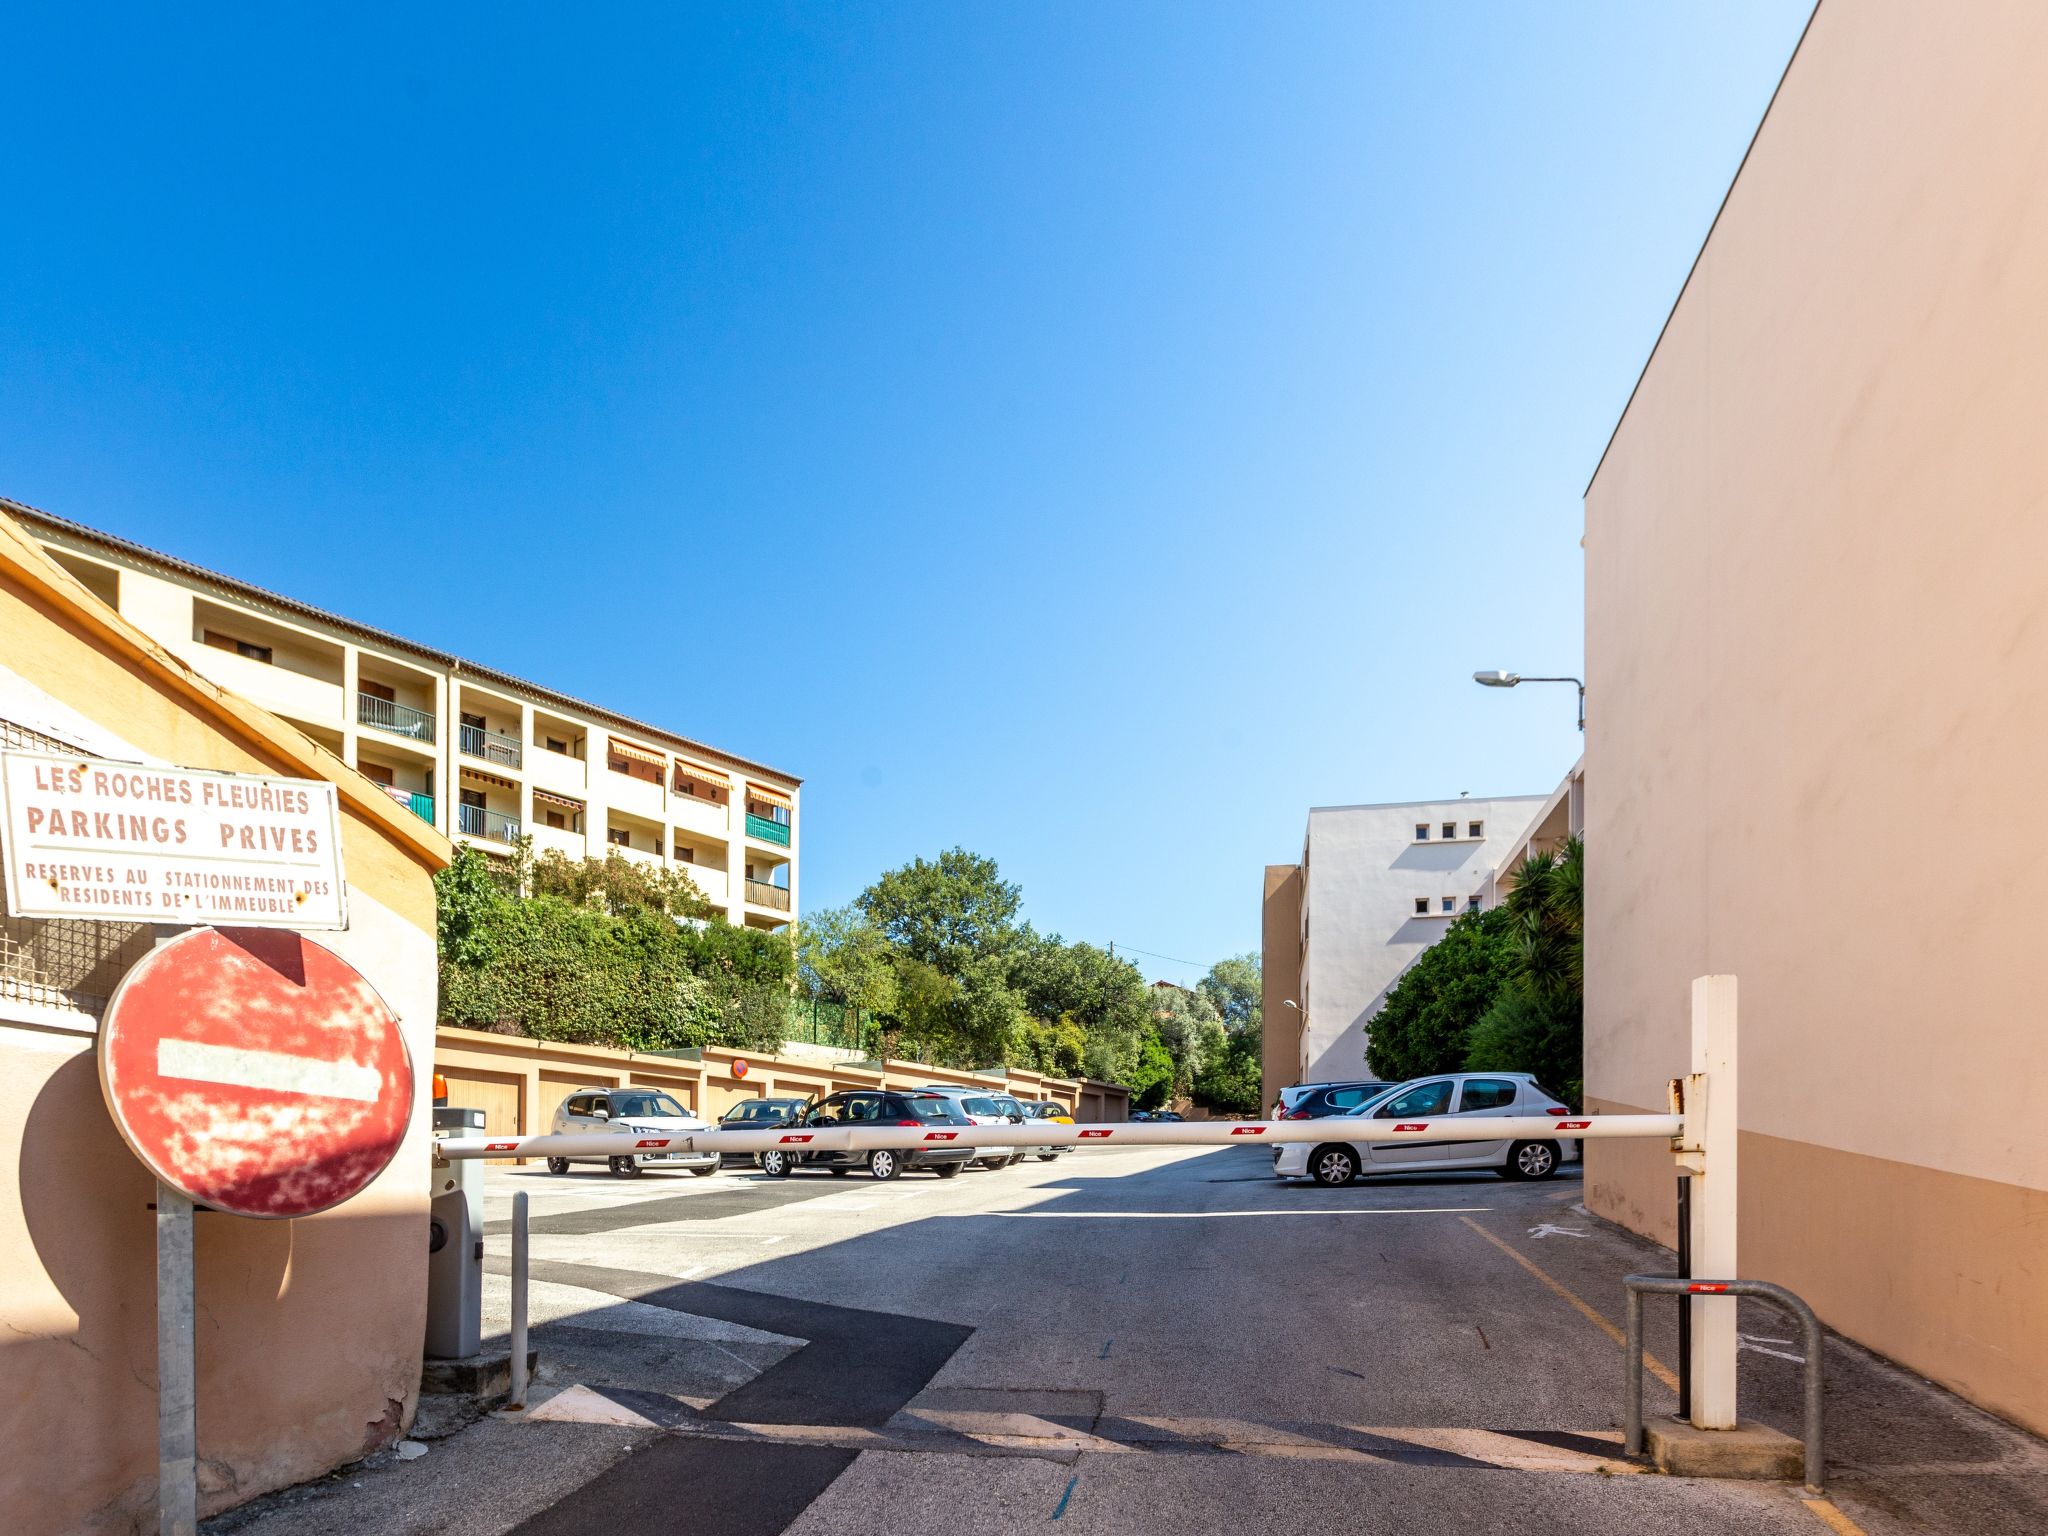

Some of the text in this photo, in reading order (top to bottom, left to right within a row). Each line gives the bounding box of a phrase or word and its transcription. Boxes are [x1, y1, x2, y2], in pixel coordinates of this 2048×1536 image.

[34, 765, 309, 815] LES ROCHES FLEURIES
[27, 806, 318, 854] PARKINGS PRIVES
[25, 862, 329, 895] RESERVES AU STATIONNEMENT DES
[60, 886, 295, 913] RESIDENTS DE L'IMMEUBLE
